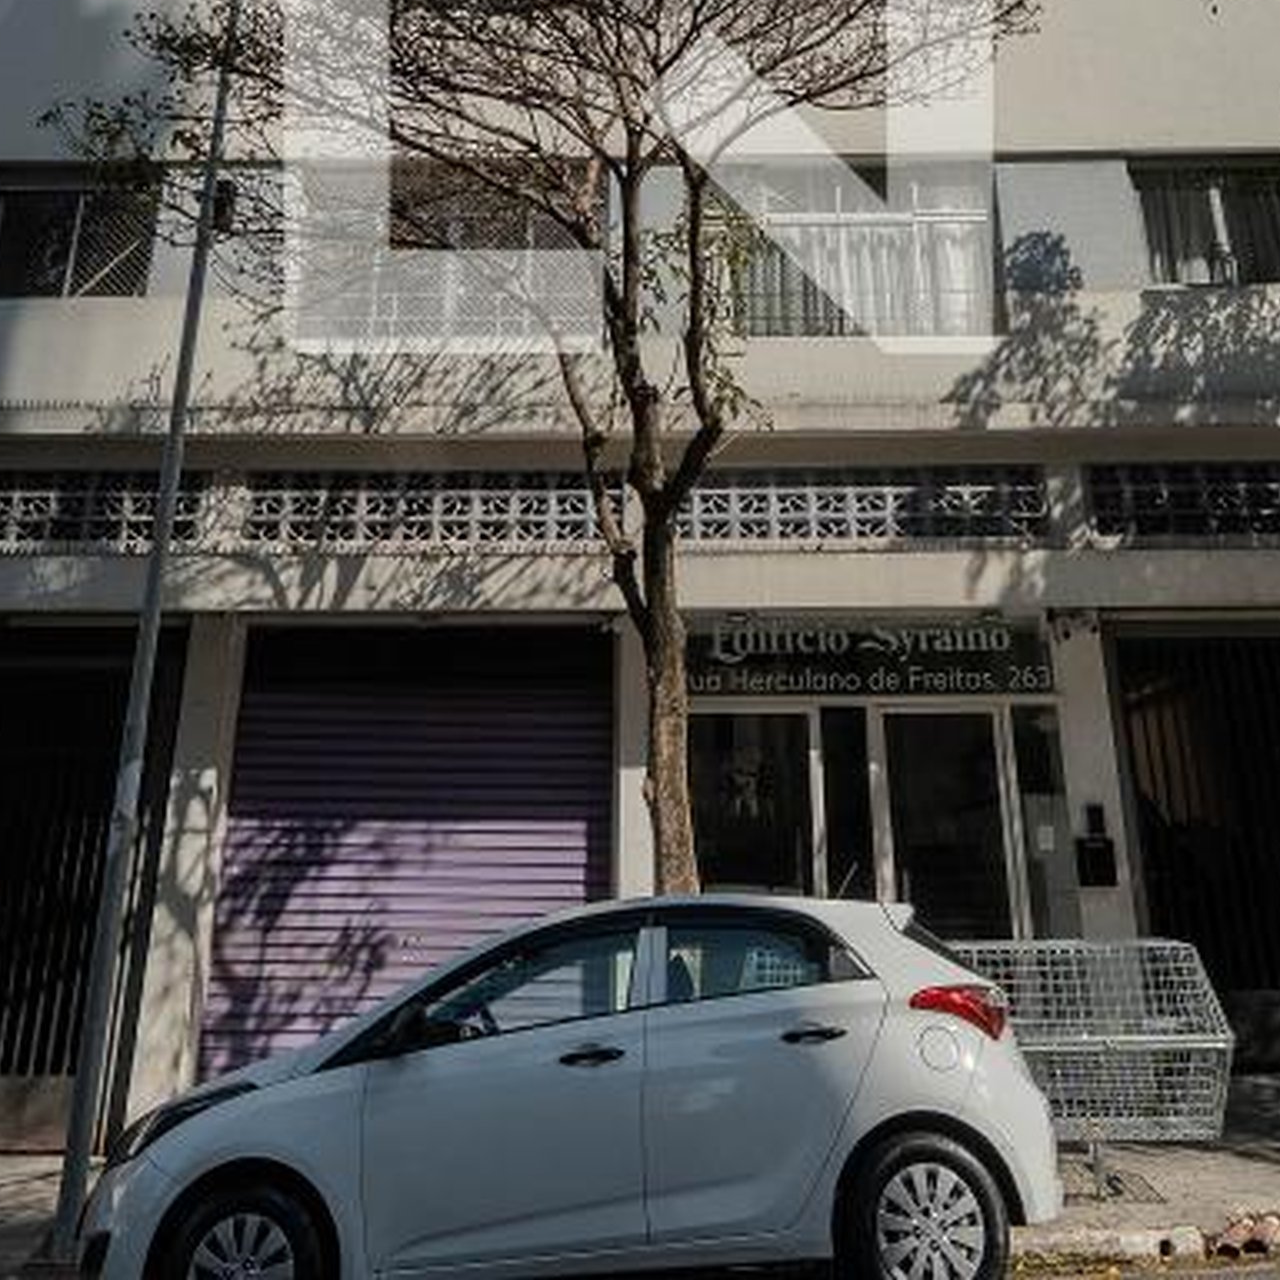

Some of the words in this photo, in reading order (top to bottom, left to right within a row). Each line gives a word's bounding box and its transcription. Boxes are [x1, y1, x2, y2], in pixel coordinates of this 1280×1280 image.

[686, 672, 721, 691] ua
[734, 668, 862, 691] Herculano
[869, 667, 900, 691] de
[1007, 666, 1053, 690] 263
